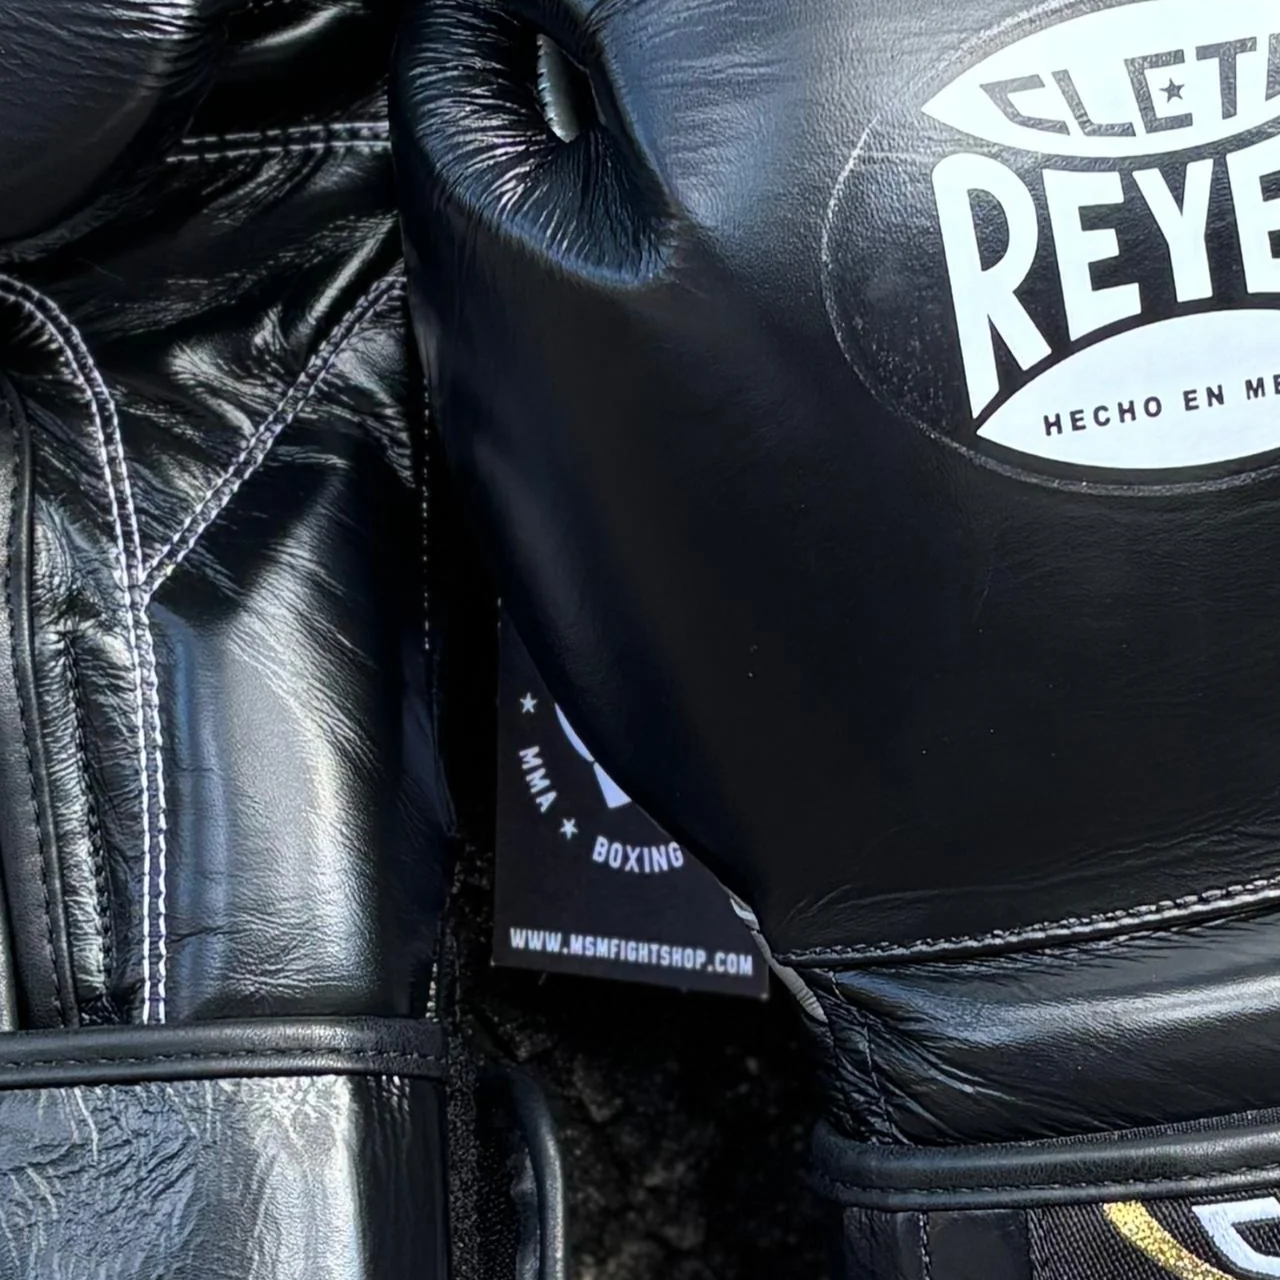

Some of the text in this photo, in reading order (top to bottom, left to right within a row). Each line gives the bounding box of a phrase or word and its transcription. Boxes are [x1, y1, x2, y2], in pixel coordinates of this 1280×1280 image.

[1042, 396, 1163, 436] HECHO
[1182, 384, 1226, 412] EN
[518, 745, 558, 814] MMA
[591, 835, 685, 873] BOXING
[509, 926, 754, 977] WWW.MSMFIGHTSHOP.COM
